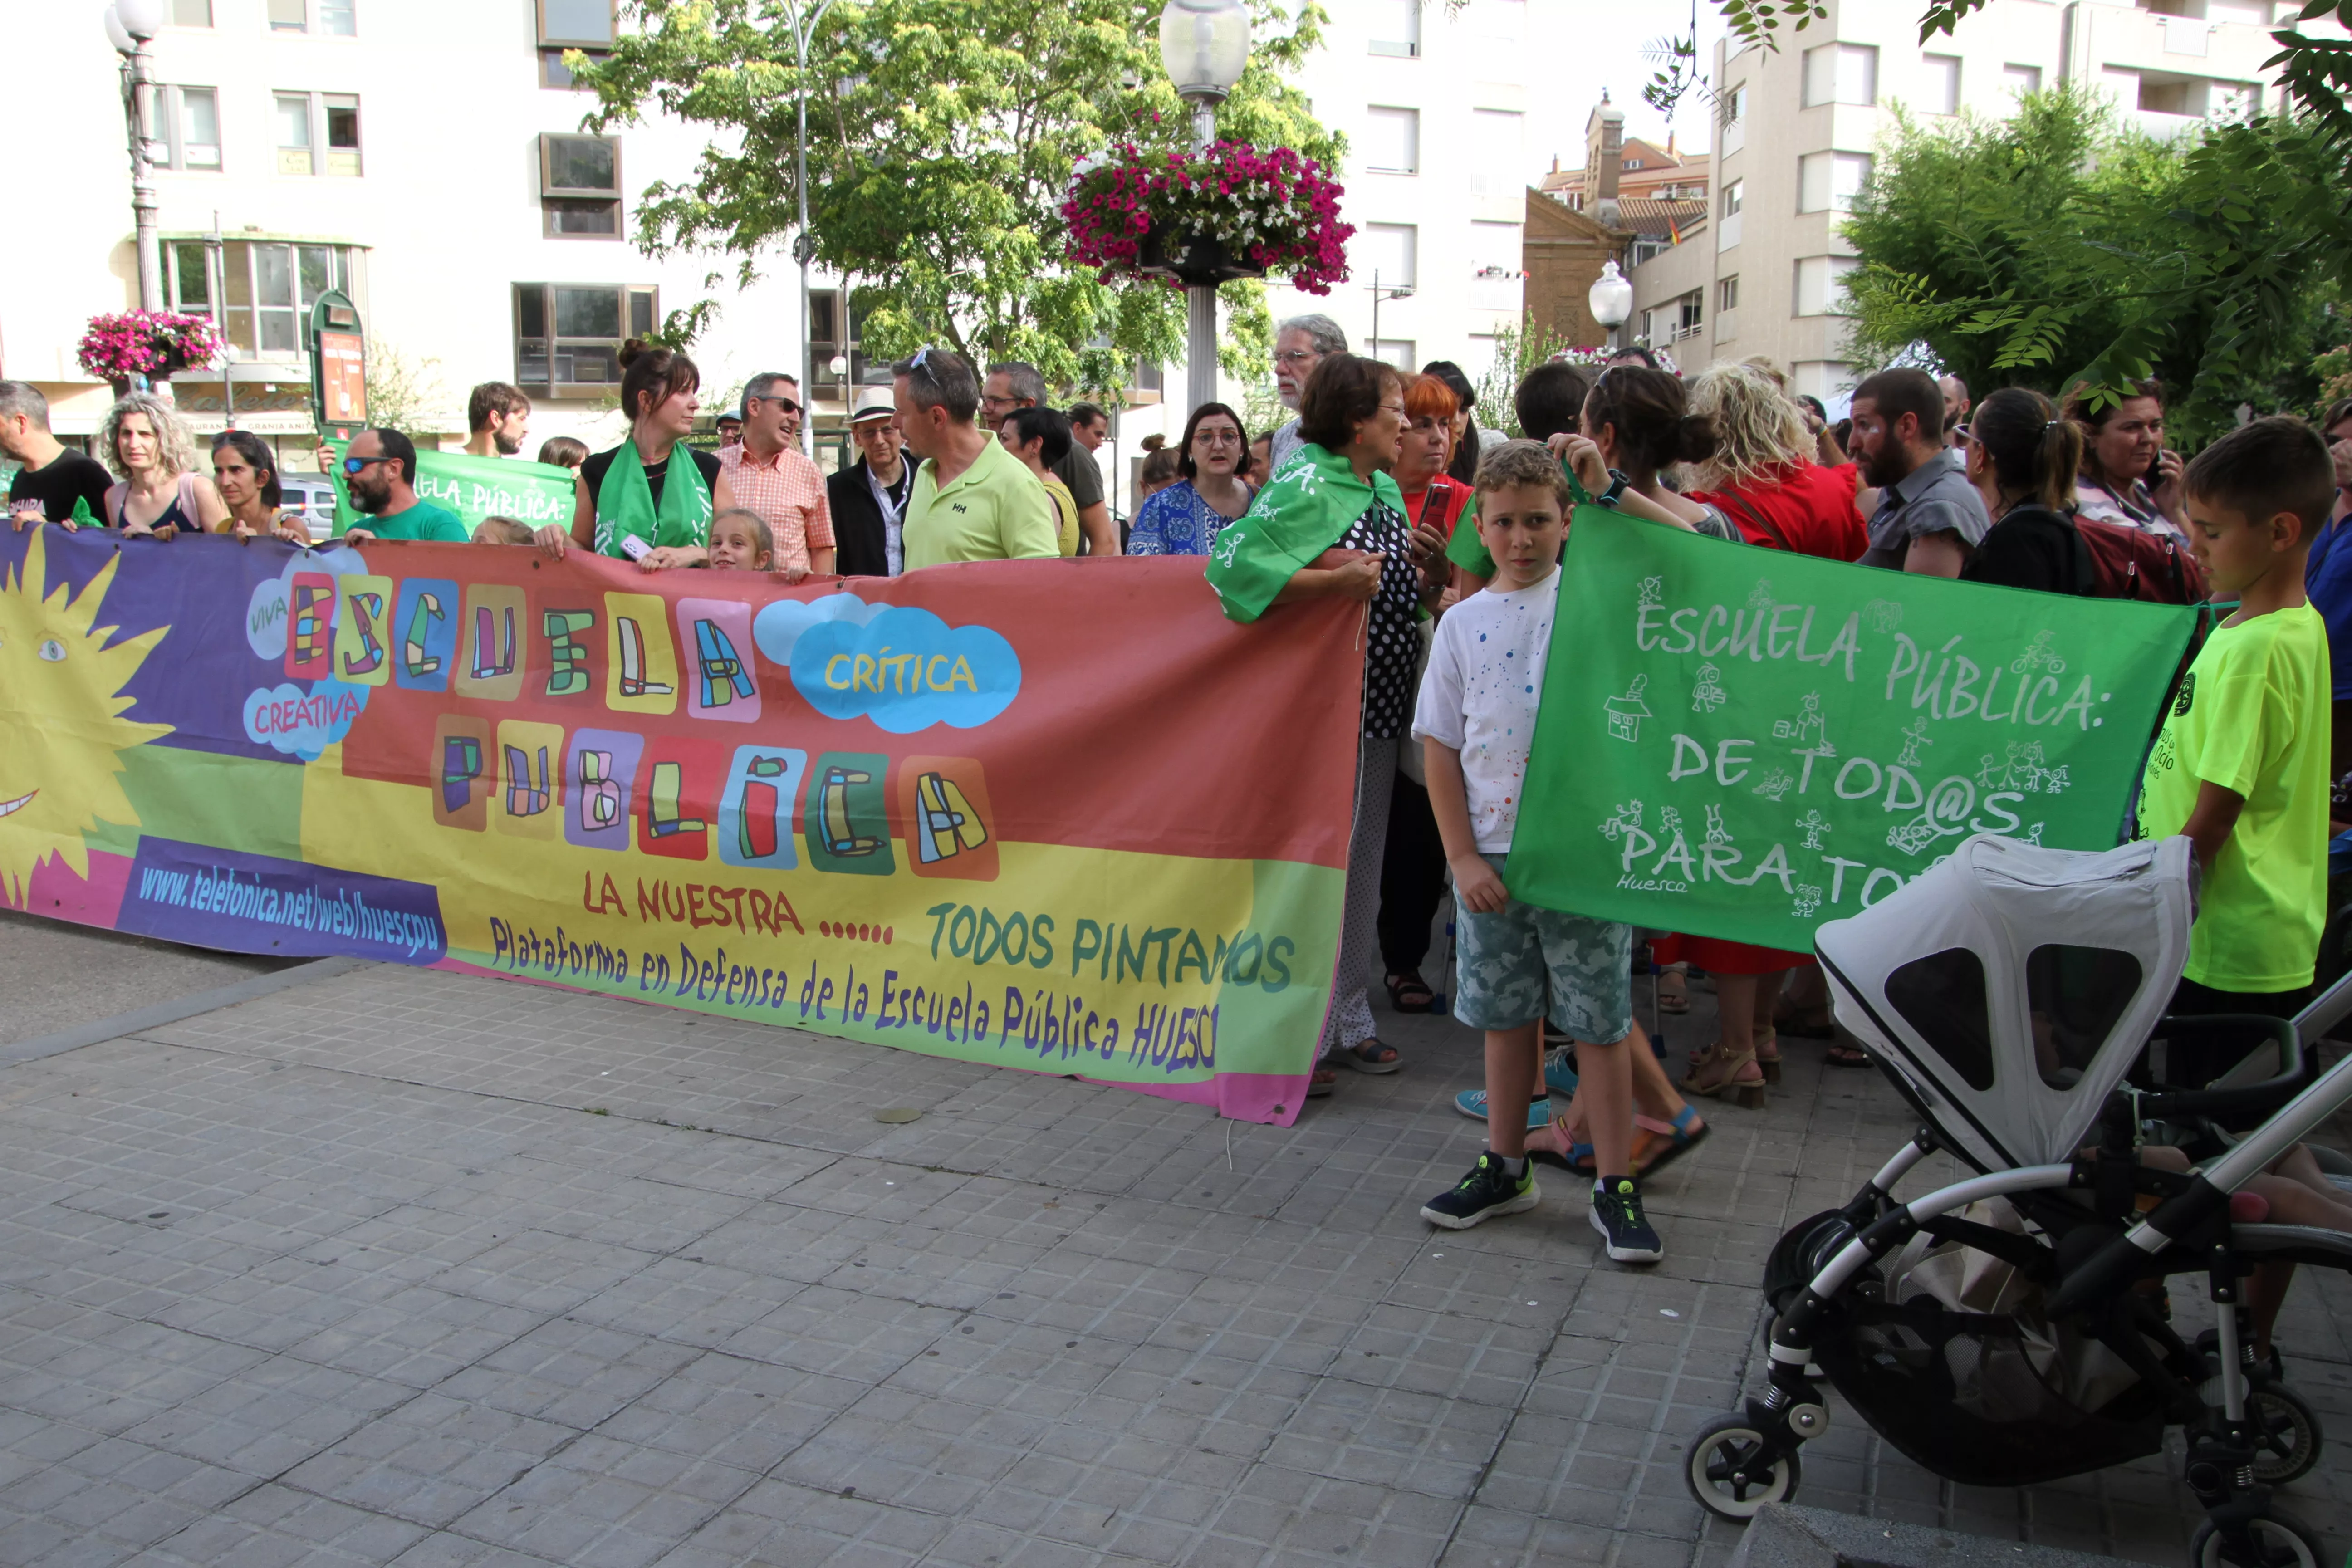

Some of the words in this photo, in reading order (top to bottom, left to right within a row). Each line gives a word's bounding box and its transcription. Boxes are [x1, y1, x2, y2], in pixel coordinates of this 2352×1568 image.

[473, 483, 567, 521] PÚBLICA:
[952, 503, 967, 514] HH
[251, 596, 288, 635] VIVA
[295, 585, 756, 709] ESCUELA
[824, 646, 978, 695] CRÍTICA
[1637, 604, 1862, 682] ESCUELA
[1886, 632, 2111, 731] PÚBLICA:
[255, 690, 363, 735] CREATIVA
[1667, 733, 1755, 786] DE
[1791, 748, 2024, 835] TOD@S
[1616, 874, 1688, 894] Huesca
[1620, 823, 1797, 895] PARA
[584, 869, 628, 918] LA
[637, 876, 805, 938] NUESTRA
[926, 902, 1055, 970] TODOS
[1072, 918, 1295, 994] PINTAMOS
[490, 916, 629, 984] Plataforma
[640, 951, 670, 994] en
[675, 941, 788, 1008] Defensa
[800, 959, 827, 1021] de
[841, 963, 869, 1025] la
[875, 969, 990, 1044] Escuela
[999, 985, 1119, 1061] Pública
